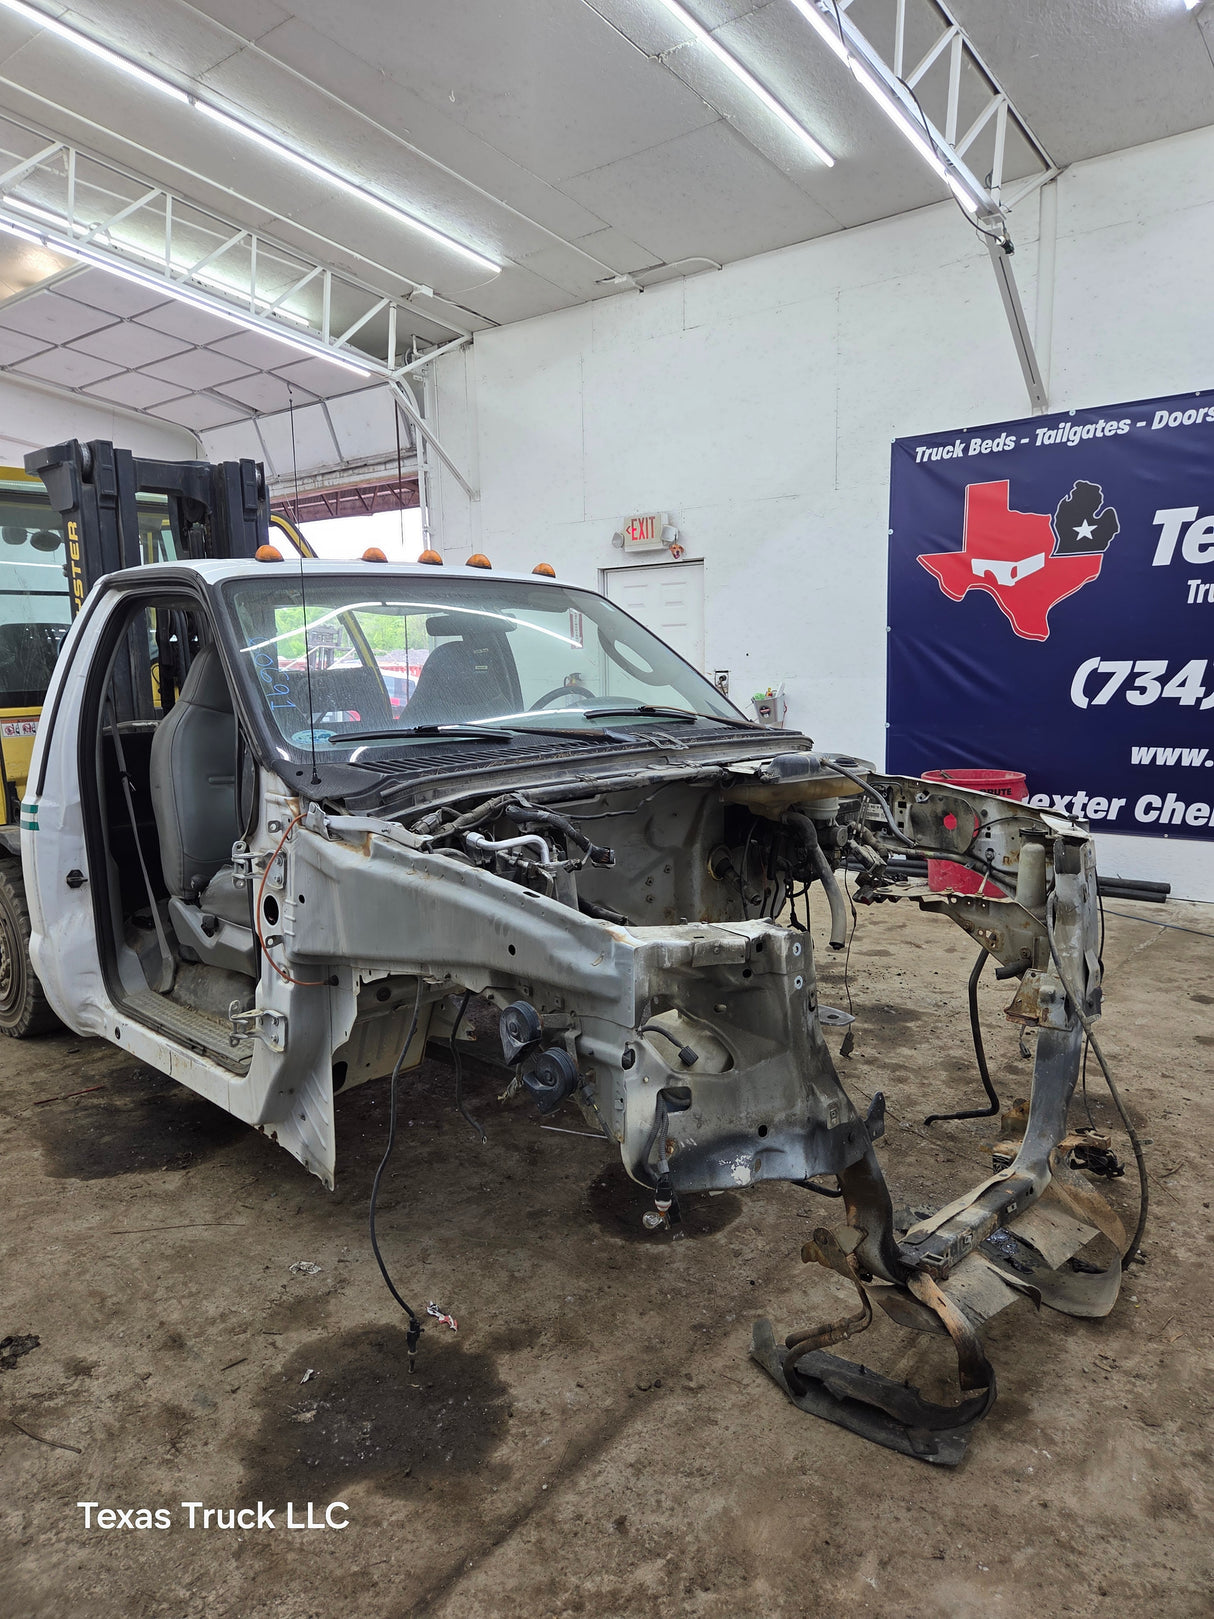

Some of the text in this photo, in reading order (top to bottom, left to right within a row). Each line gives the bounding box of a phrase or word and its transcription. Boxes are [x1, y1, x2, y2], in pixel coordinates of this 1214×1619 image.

[915, 439, 966, 463] Truck
[968, 432, 1017, 456] Beds
[1035, 418, 1131, 446] Tailgates
[631, 516, 656, 541] EXIT
[1152, 505, 1214, 567] Te
[1131, 746, 1214, 767] www.
[1022, 790, 1214, 827] exter Che
